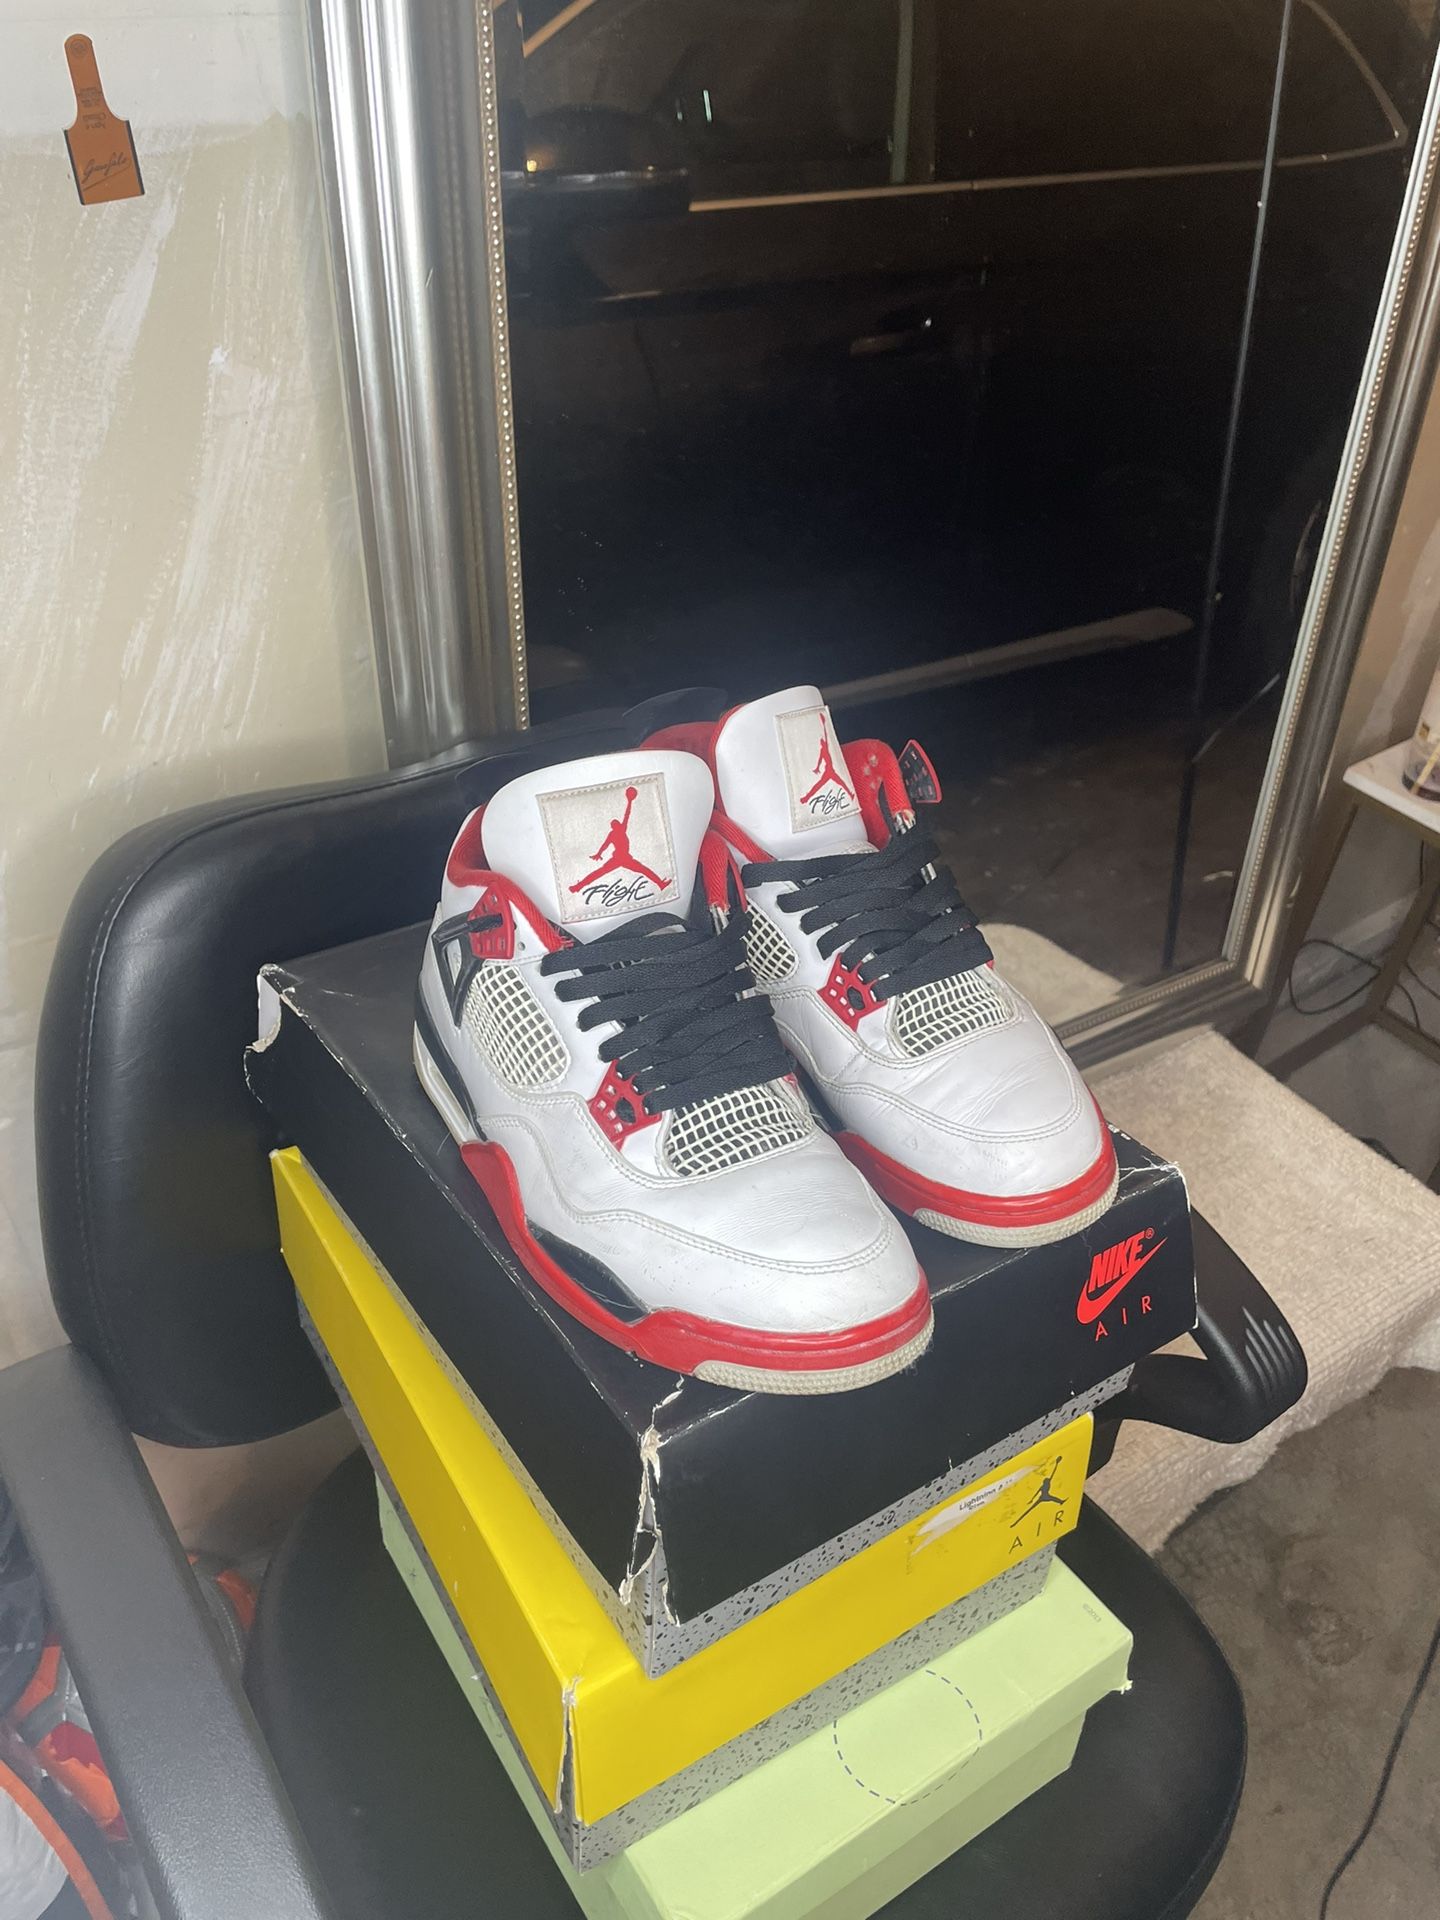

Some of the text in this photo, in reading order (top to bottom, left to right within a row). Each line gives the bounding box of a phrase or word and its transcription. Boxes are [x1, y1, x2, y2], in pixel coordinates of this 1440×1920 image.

[809, 787, 850, 815] Flight
[582, 876, 655, 907] Flight
[1096, 1295, 1152, 1341] AIR
[1008, 1510, 1065, 1554] AIR
